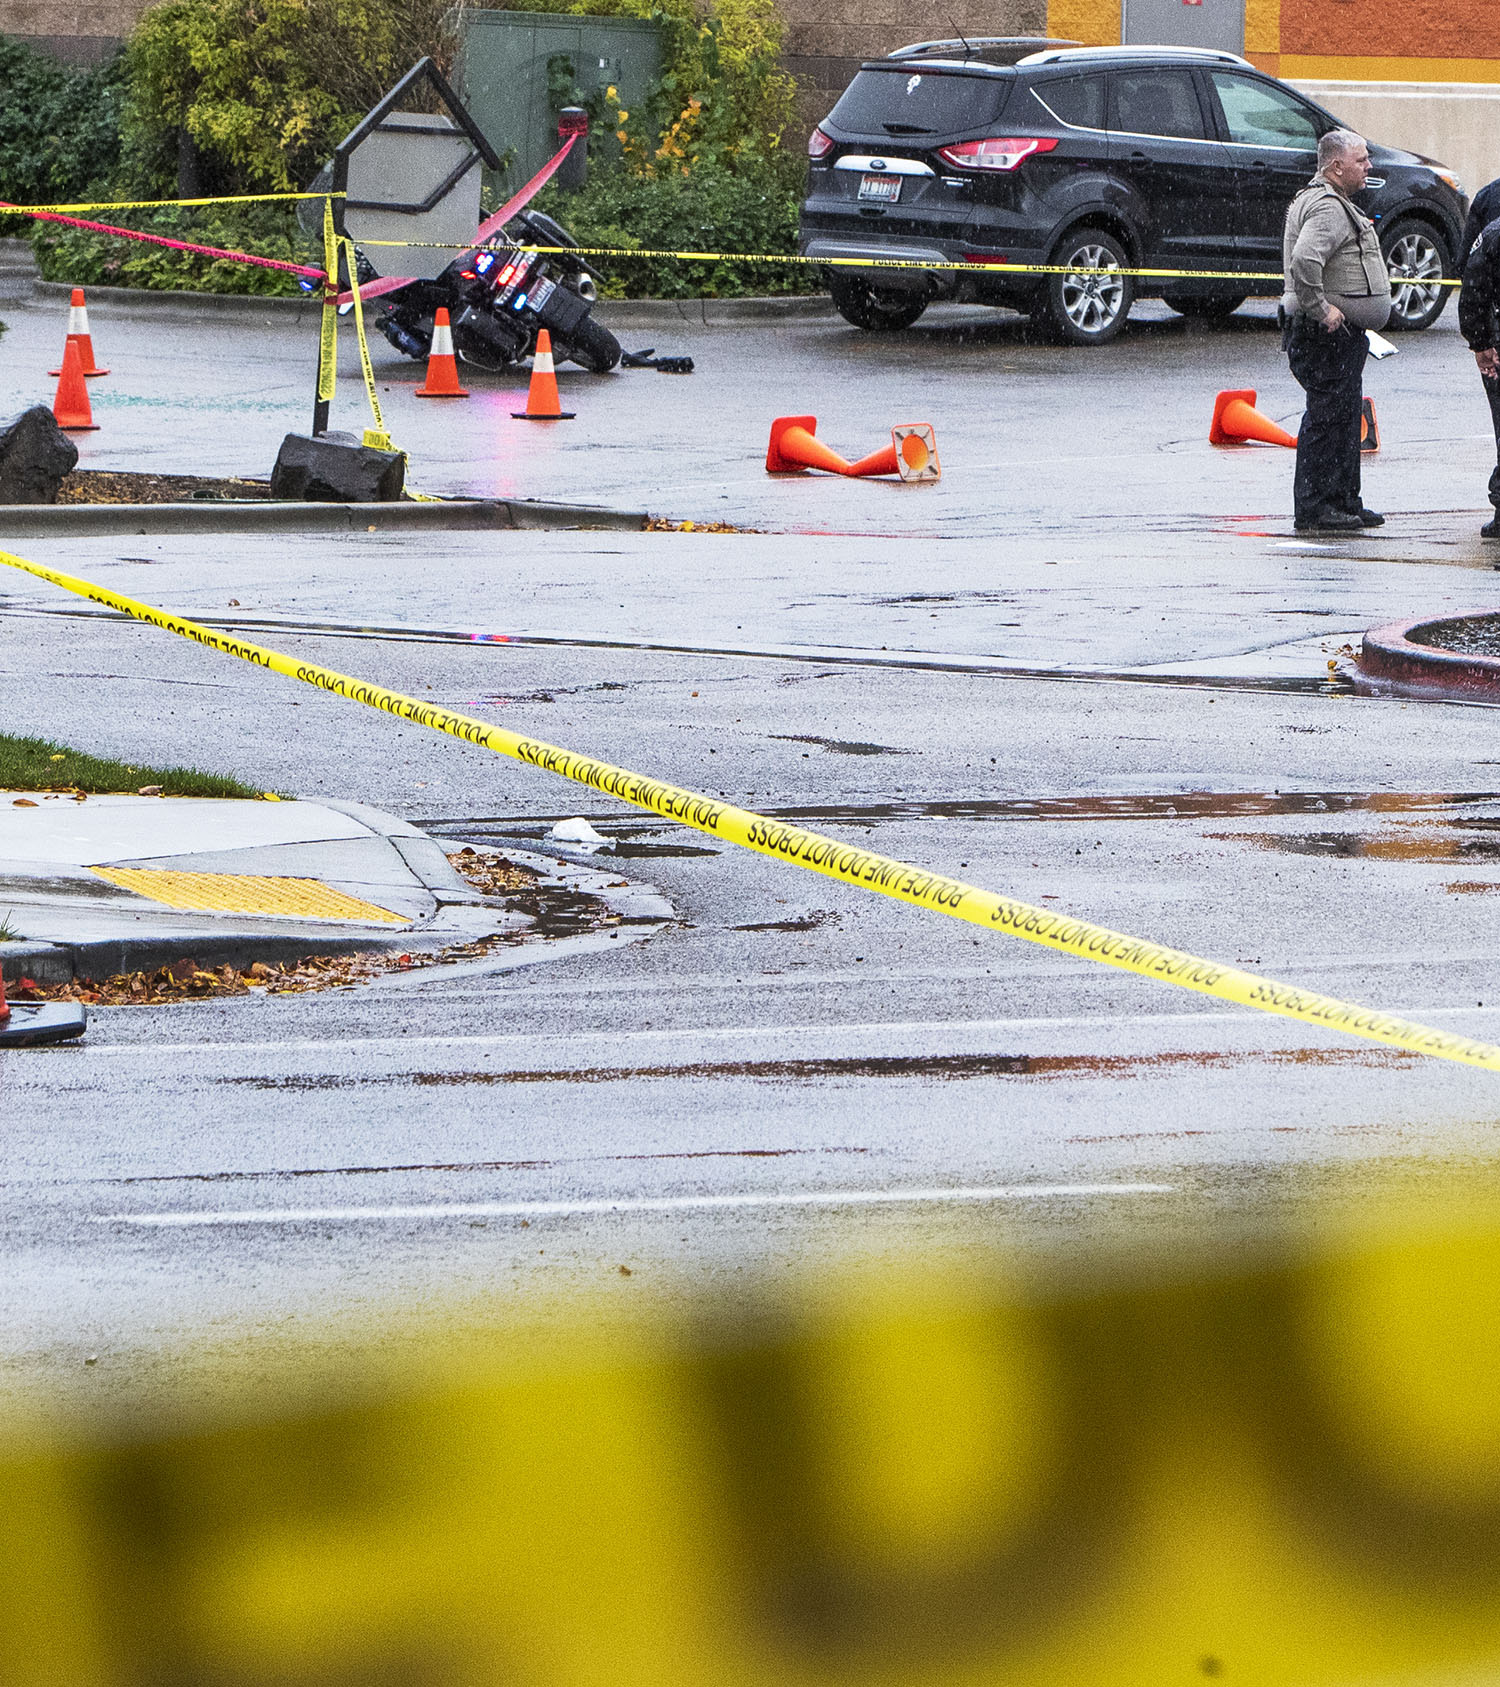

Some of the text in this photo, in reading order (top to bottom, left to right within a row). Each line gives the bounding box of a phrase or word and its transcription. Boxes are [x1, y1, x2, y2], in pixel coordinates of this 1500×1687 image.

[517, 742, 726, 830] POLICE LINE DO NOT CROSS
[747, 820, 969, 909] POLICE LINE DO NOT CROSS
[991, 902, 1228, 987] POLICE LINE DO NOT CROSS
